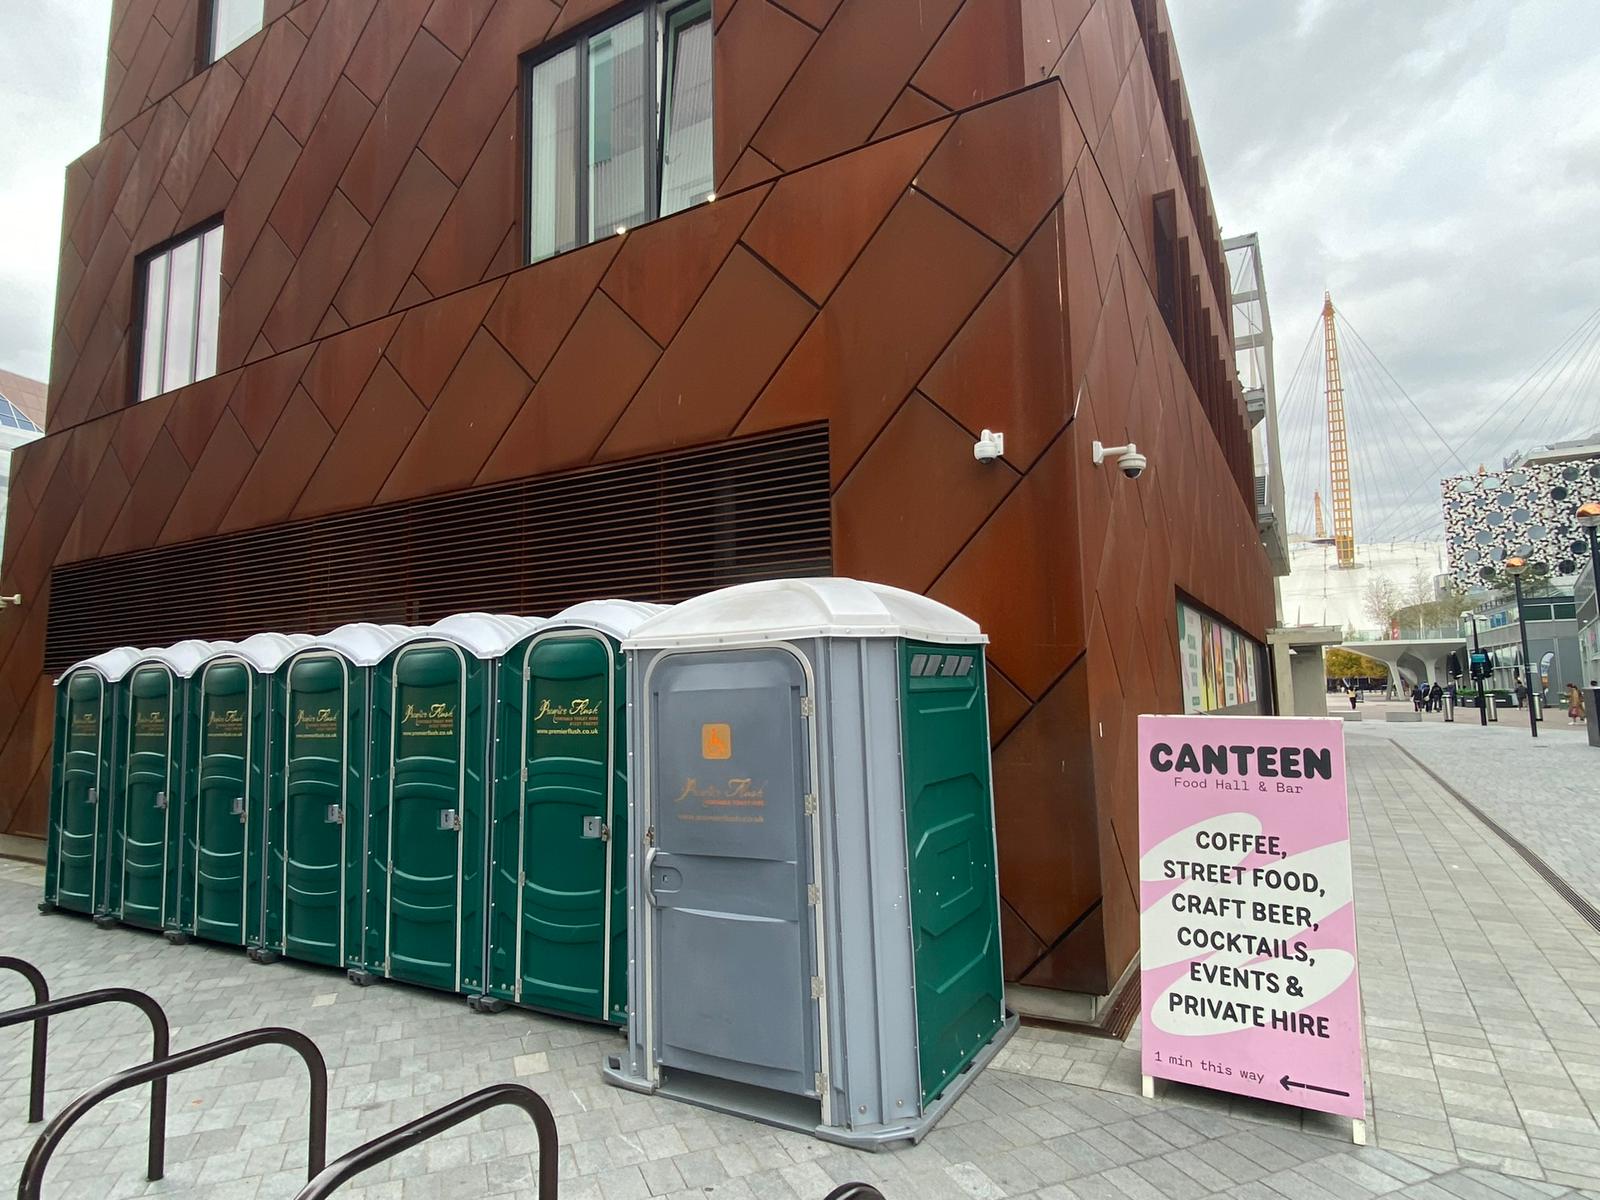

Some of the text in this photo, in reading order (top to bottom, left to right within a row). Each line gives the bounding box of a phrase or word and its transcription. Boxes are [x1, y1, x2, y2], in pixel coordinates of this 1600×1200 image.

[1150, 743, 1332, 780] CANTEEN
[1174, 777, 1303, 794] Food Hall & Bar
[1196, 830, 1287, 859] COFFEE,
[1163, 860, 1326, 897] STREET FOOD,
[1171, 893, 1319, 931] CRAFT BEER,
[1177, 926, 1315, 966] COCKTAILS,
[1190, 962, 1304, 997] EVENTS &
[1169, 992, 1330, 1039] PRIVATE HIRE
[1154, 1051, 1265, 1084] 1 min this way
